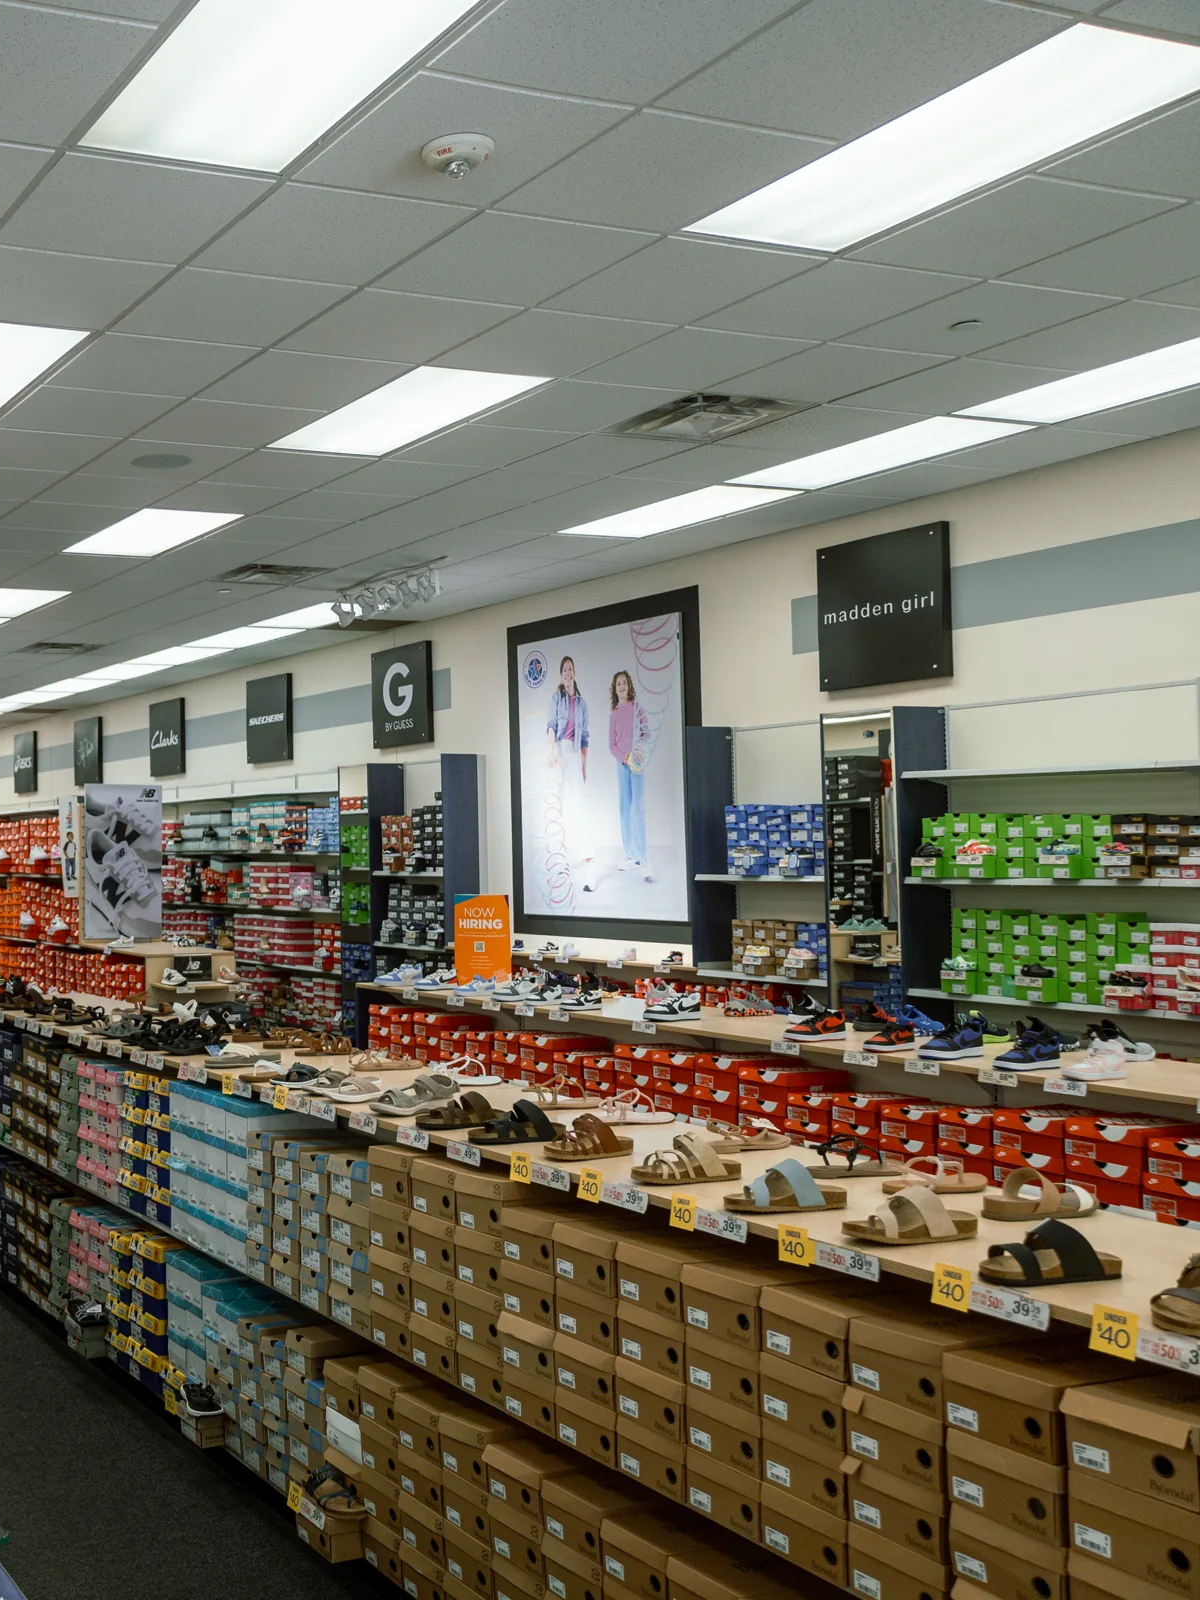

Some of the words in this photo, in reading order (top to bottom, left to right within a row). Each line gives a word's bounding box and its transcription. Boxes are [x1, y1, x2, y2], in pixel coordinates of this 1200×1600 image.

[823, 602, 893, 625] madden
[901, 591, 934, 613] girl
[382, 662, 413, 717] G
[249, 713, 285, 726] SKECHERS
[385, 722, 393, 732] BY
[393, 719, 414, 730] GUESS
[151, 730, 179, 750] Clarks
[464, 907, 495, 917] NOW
[459, 918, 503, 929] HIRING
[516, 1155, 527, 1163] UNDER
[513, 1163, 528, 1178] $40
[585, 1172, 597, 1180] UNDER
[581, 1180, 598, 1196] $40
[677, 1197, 690, 1206] UNDER
[673, 1207, 691, 1223] $40
[785, 1229, 801, 1239] UNDER
[782, 1238, 805, 1258] $40
[943, 1269, 962, 1281] UNDER
[937, 1279, 964, 1302] $40
[1103, 1311, 1127, 1325] UNDER
[1096, 1322, 1131, 1349] $40
